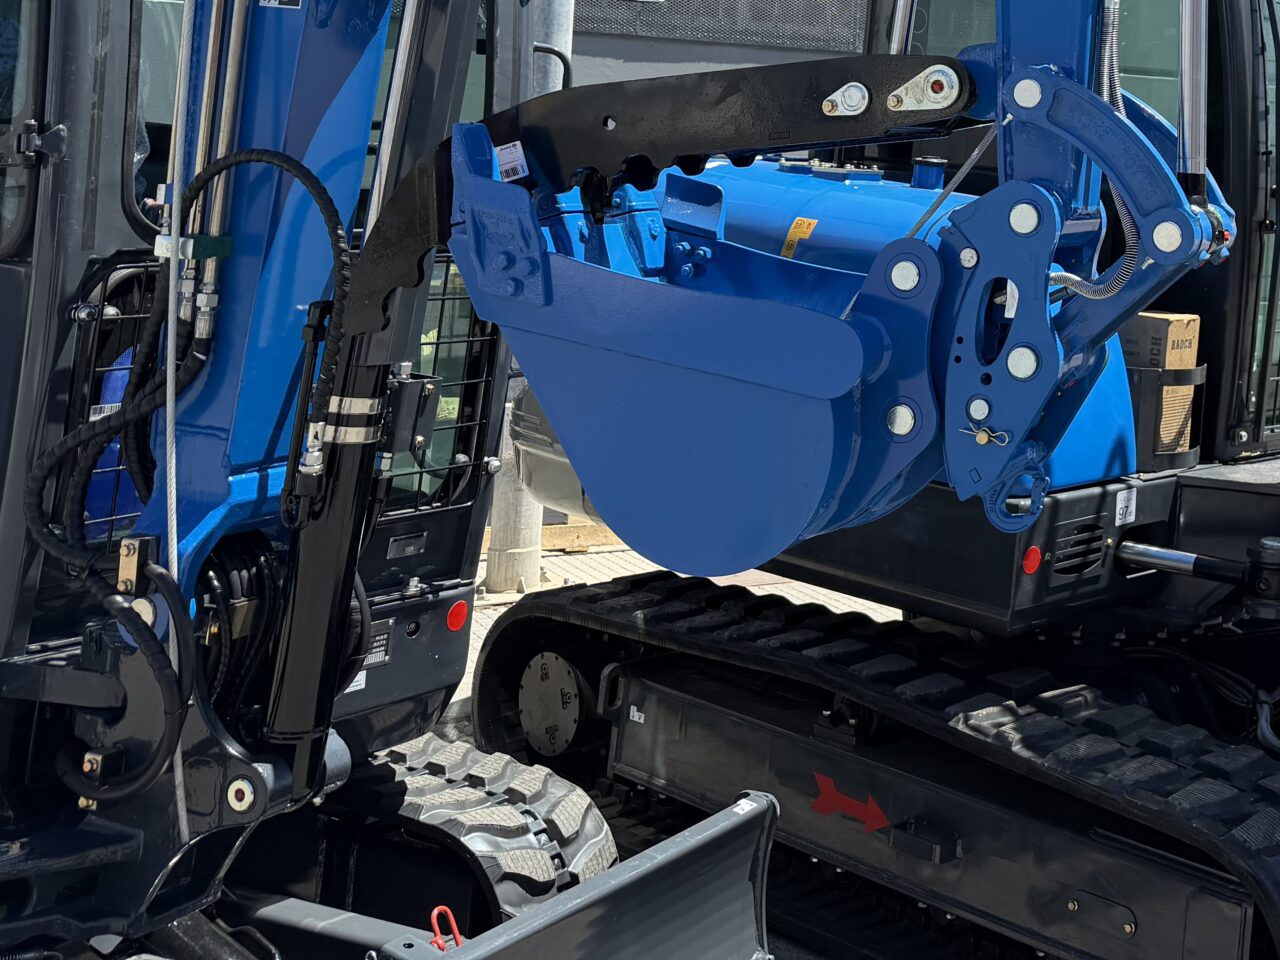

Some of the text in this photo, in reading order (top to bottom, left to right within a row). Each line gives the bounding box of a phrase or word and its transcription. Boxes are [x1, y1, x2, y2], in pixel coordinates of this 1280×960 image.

[1149, 336, 1162, 368] OCH
[1171, 338, 1193, 350] BAOCH
[1118, 505, 1129, 521] 97
